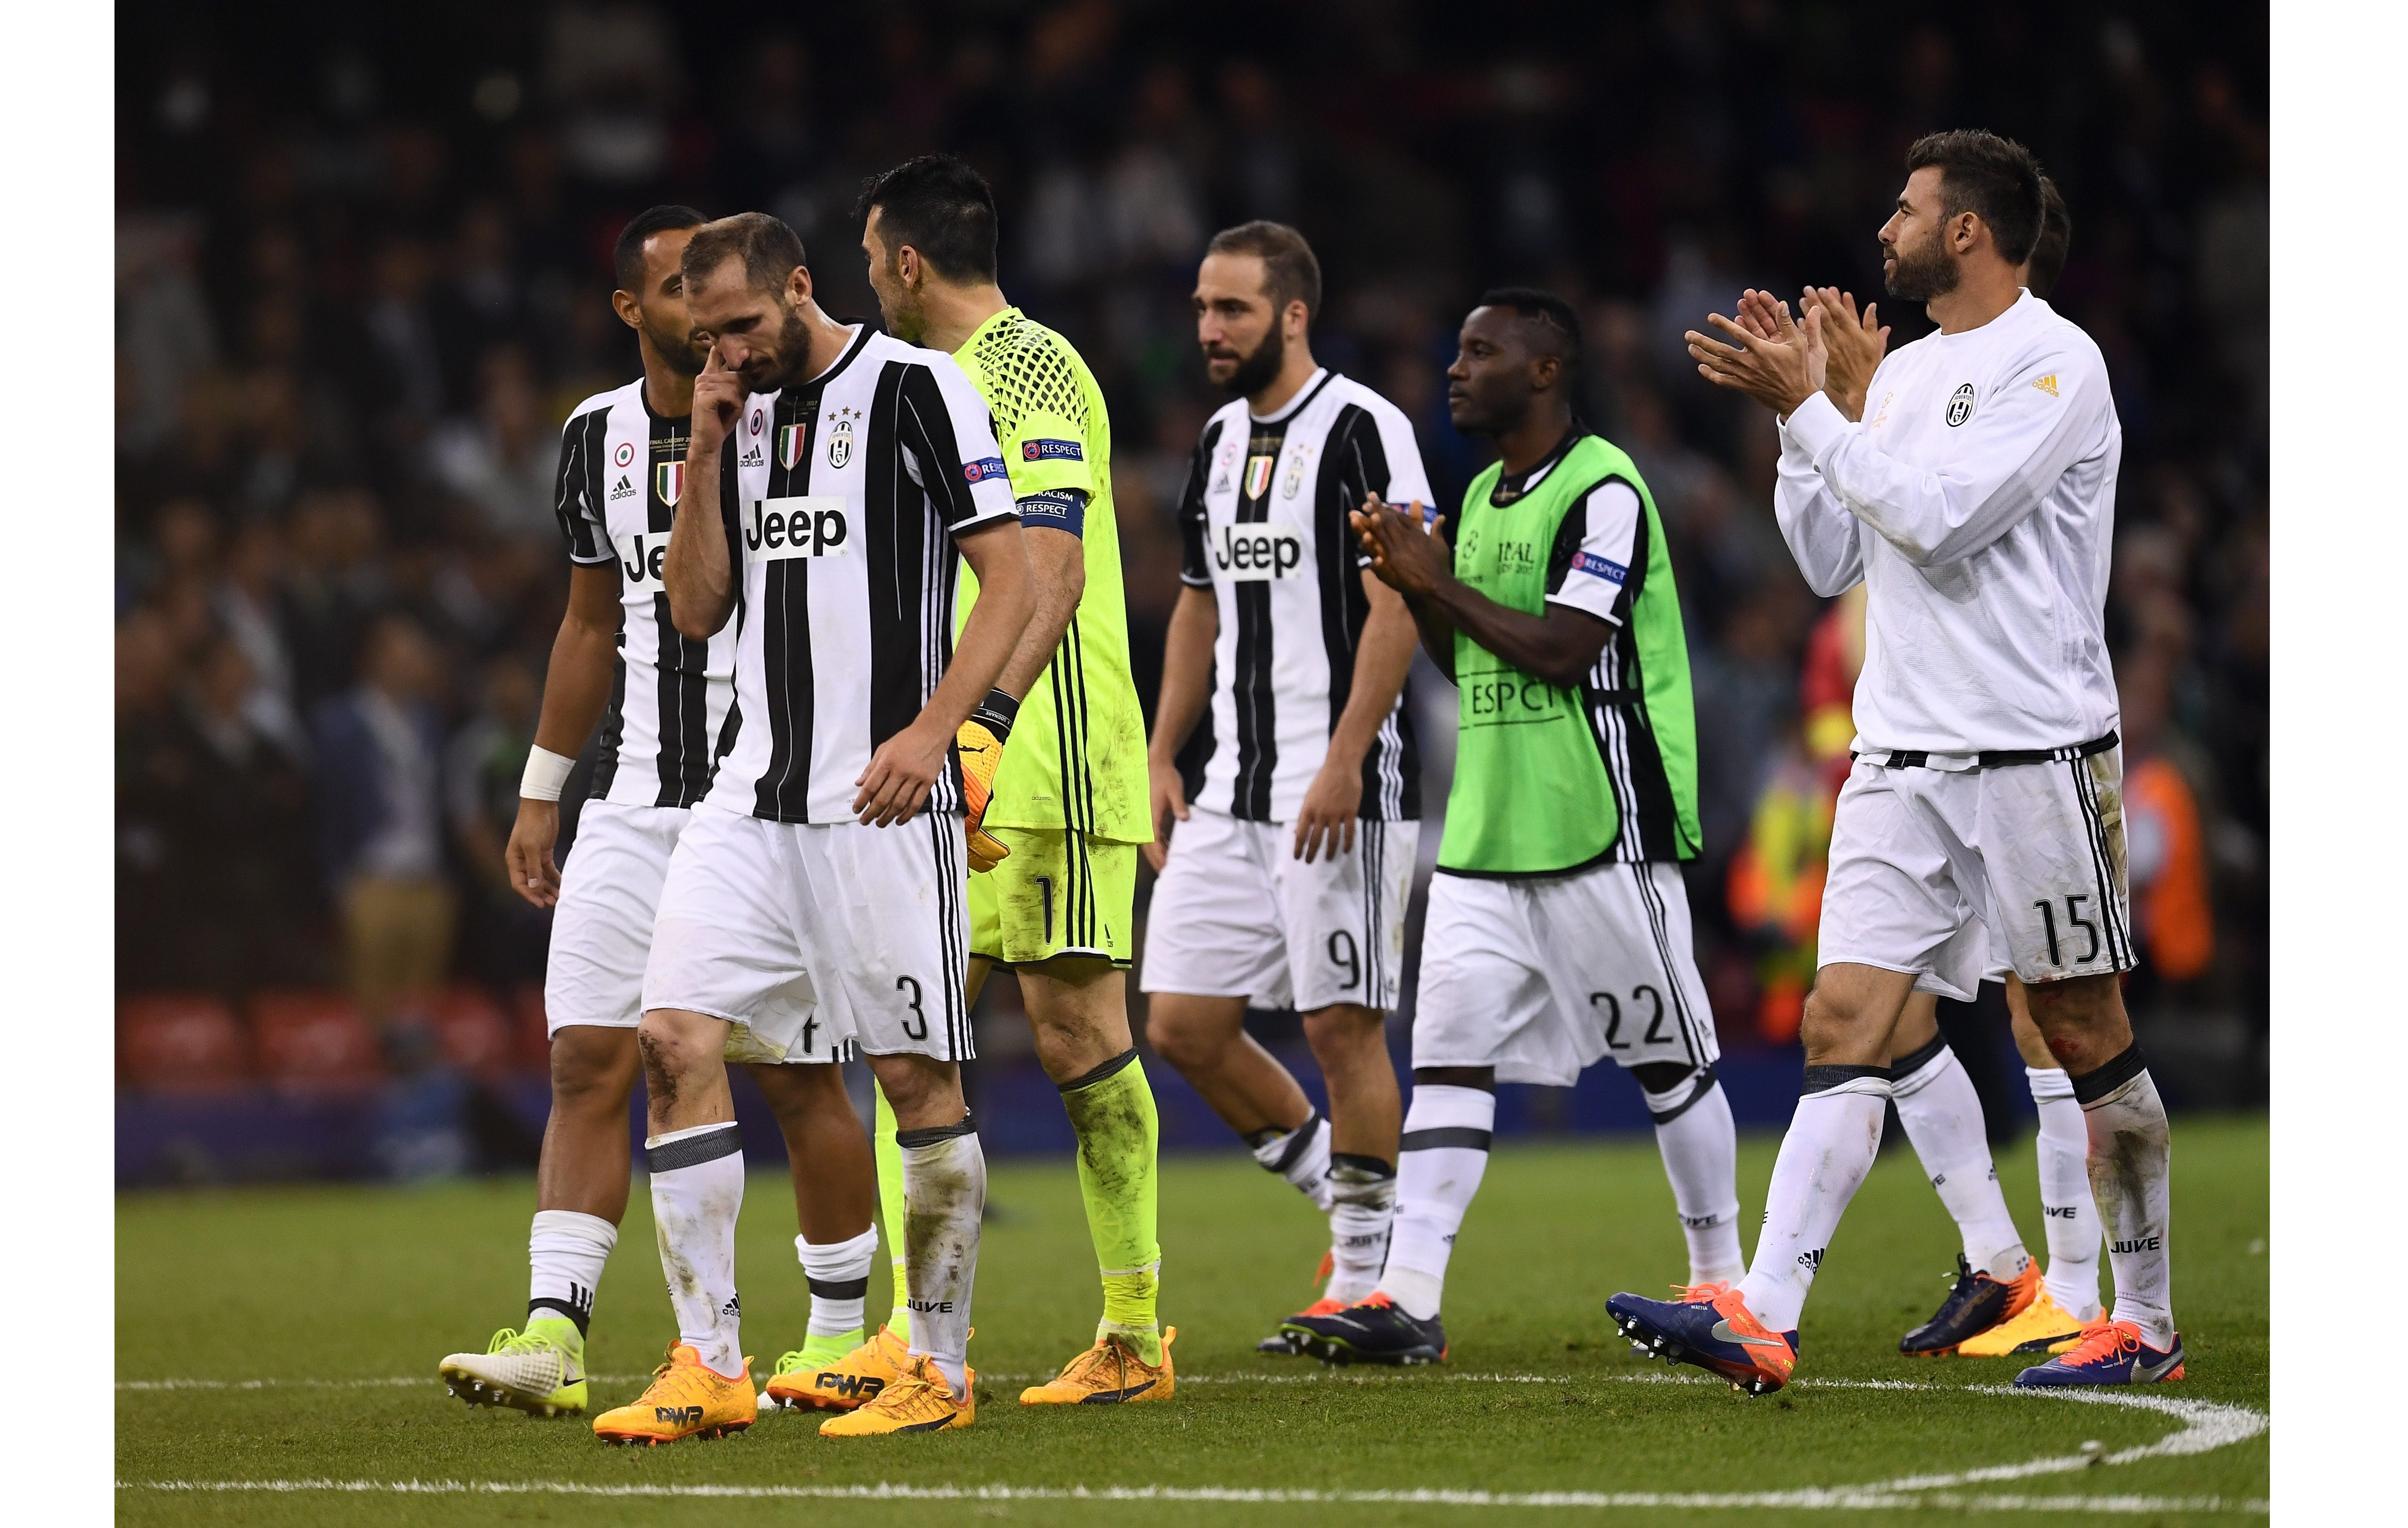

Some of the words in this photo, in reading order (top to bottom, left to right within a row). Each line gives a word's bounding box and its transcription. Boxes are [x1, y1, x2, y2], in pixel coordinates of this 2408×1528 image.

[2032, 382, 2059, 397] adidas
[740, 459, 764, 467] adidas
[1042, 444, 1081, 456] RESPECT
[610, 489, 637, 500] adidas
[1026, 504, 1067, 515] RESPECT
[746, 500, 847, 556] Jeep
[625, 535, 664, 582] Je
[1216, 527, 1300, 578] Jeep
[1034, 876, 1053, 945] 1
[2033, 894, 2101, 968] 15
[1328, 929, 1359, 989] 9
[896, 975, 928, 1041] 3
[1590, 985, 1674, 1049] 22
[2111, 1236, 2160, 1253] JUVE
[907, 1299, 952, 1313] JUVE
[815, 1372, 885, 1399] PWR
[655, 1406, 704, 1428] PWR
